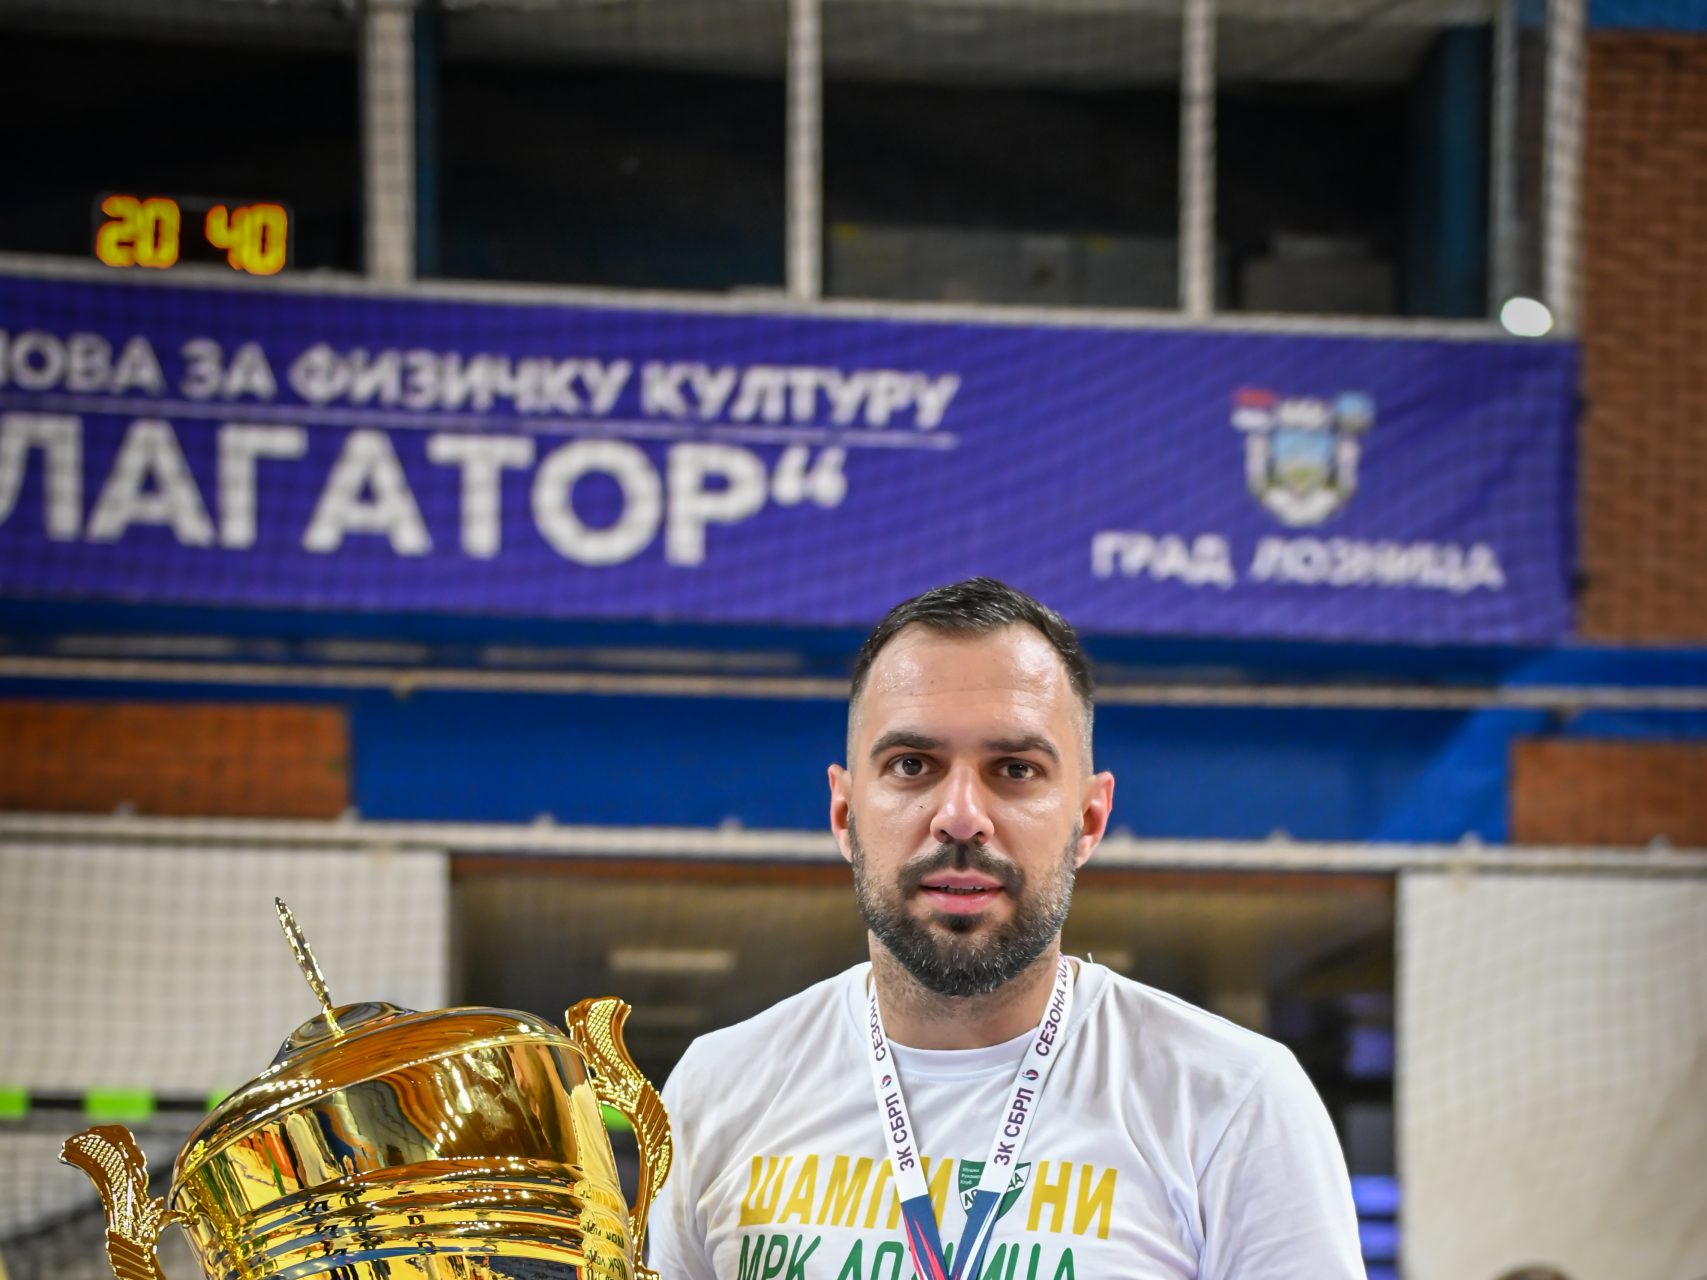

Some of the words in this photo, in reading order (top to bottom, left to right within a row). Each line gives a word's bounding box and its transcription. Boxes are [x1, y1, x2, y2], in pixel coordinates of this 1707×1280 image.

[95, 195, 180, 269] 20
[205, 203, 289, 276] 40
[0, 329, 165, 394] ОВА
[180, 339, 278, 398] ЗА
[288, 343, 631, 415] ФИЗИЧКУ
[642, 361, 960, 430] КУЛТУРУ
[1091, 530, 1235, 590] ГРАД
[1250, 536, 1505, 594] ЛОЗНИЦА
[1035, 988, 1067, 1056] СЕЗОНА
[885, 1091, 909, 1144] СБРЛ
[1004, 1087, 1035, 1138] СБРЛ
[896, 1146, 915, 1172] ЗК
[993, 1141, 1016, 1166] ЗК
